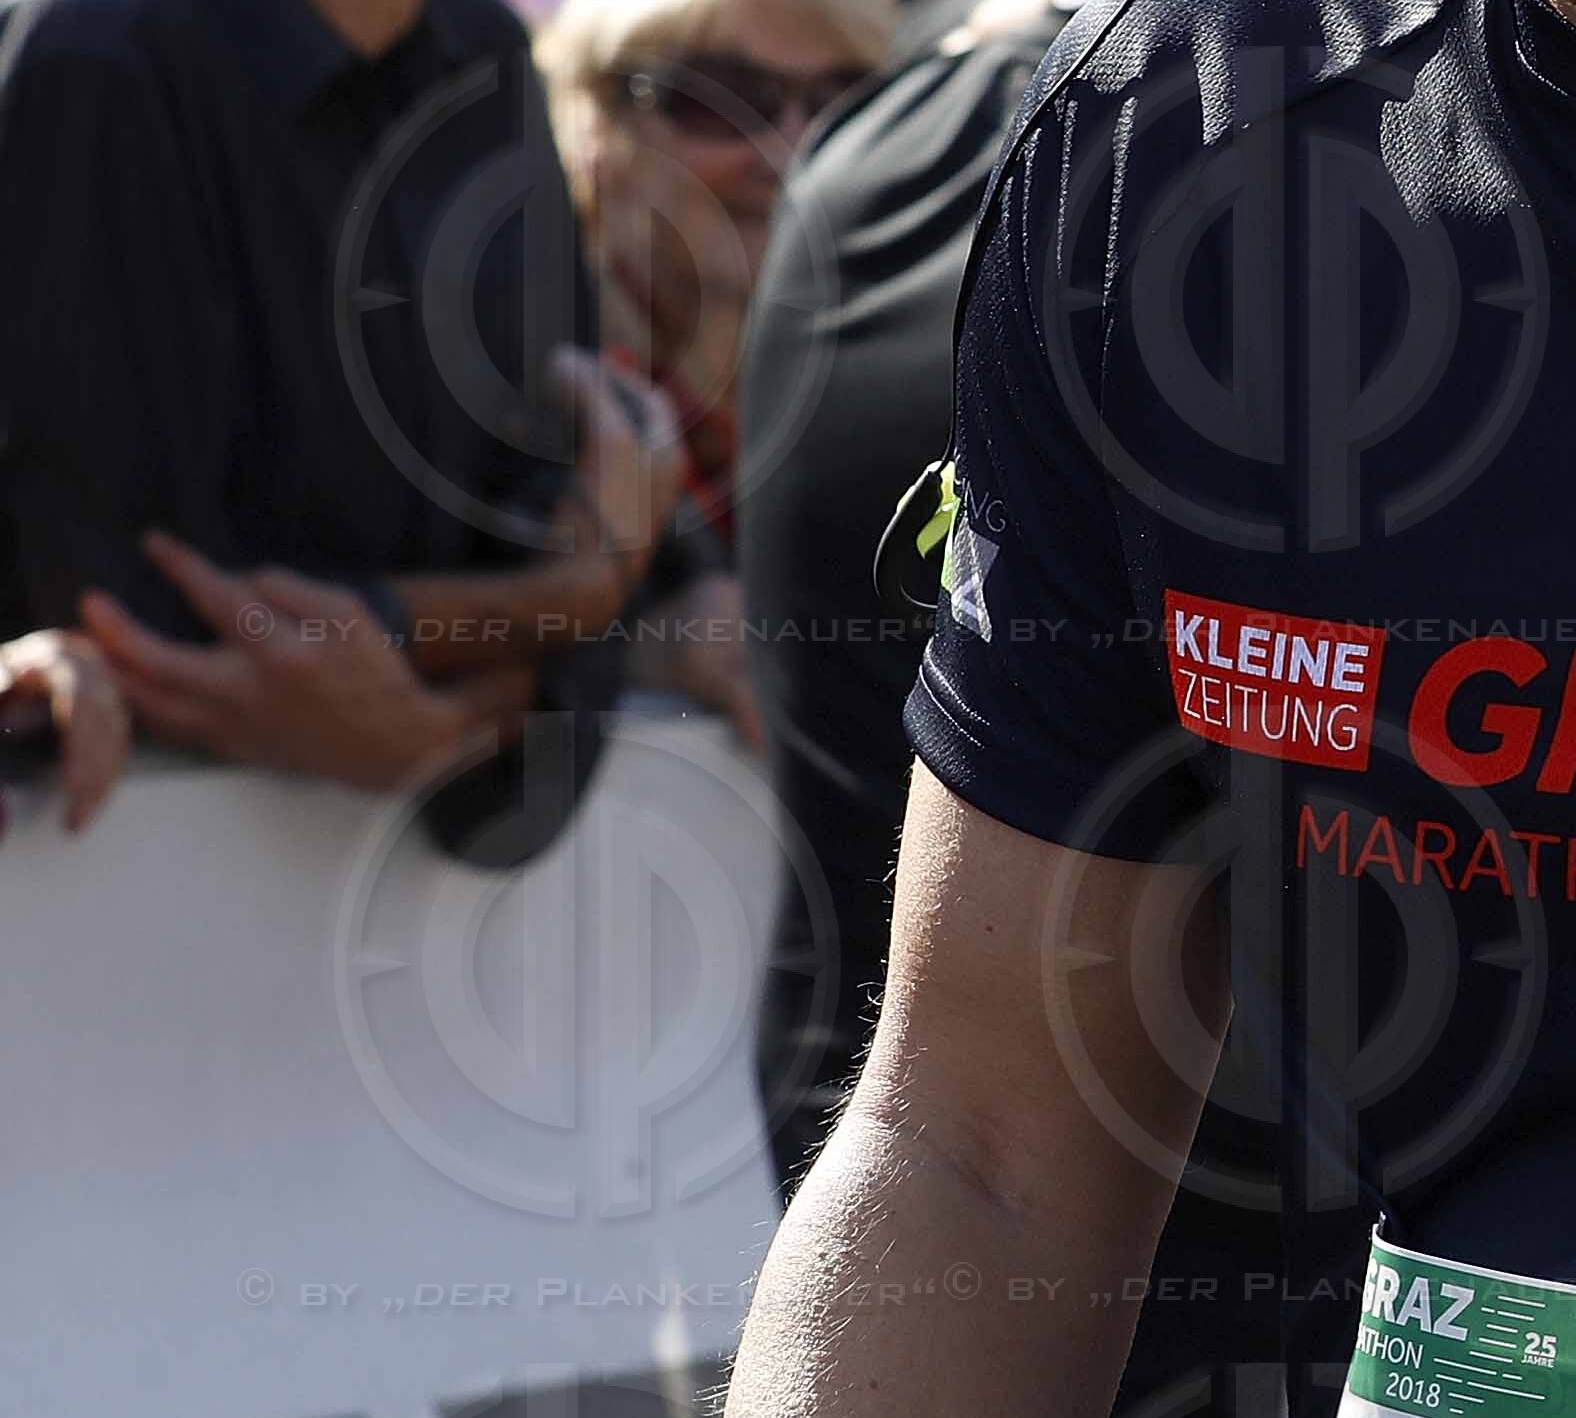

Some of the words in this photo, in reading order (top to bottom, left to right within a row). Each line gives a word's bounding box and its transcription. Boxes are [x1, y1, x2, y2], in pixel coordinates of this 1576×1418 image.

[1174, 609, 1369, 694] KLEINE
[1176, 667, 1359, 753] ZEITUNG
[1522, 1331, 1558, 1360] 25
[1385, 1371, 1441, 1409] 2018
